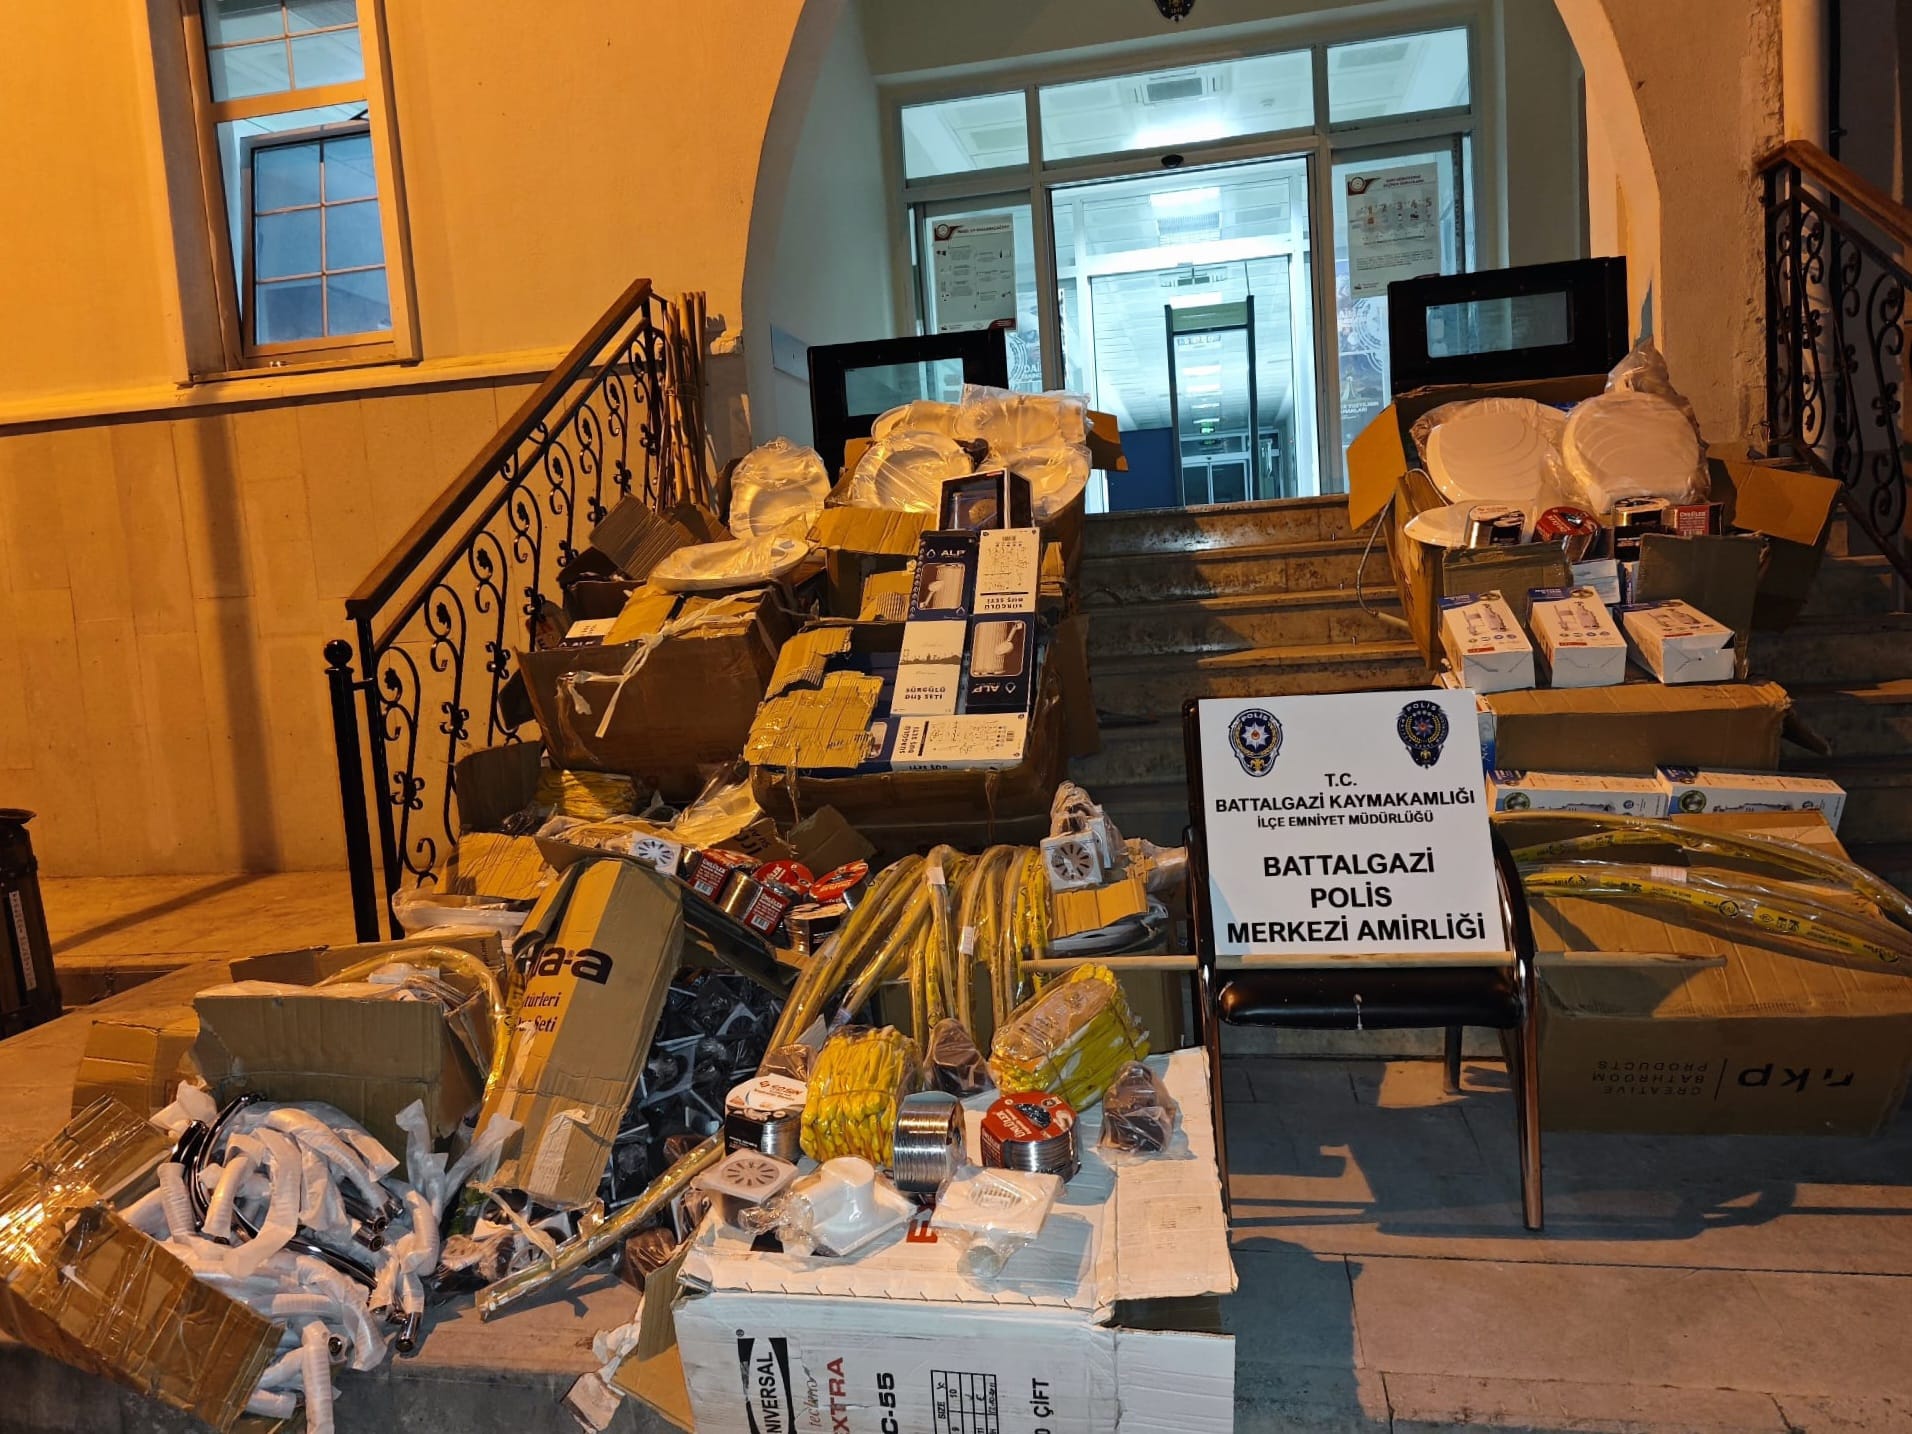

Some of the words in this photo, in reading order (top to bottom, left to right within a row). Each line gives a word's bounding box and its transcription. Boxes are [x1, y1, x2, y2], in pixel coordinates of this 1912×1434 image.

[1324, 772, 1358, 787] T.C.
[1215, 792, 1325, 813] BATTALGAZİ
[1329, 787, 1475, 809] KAYMAKAMLIĞI
[1257, 814, 1285, 829] İLÇE
[1288, 812, 1345, 828] EMNİYET
[1348, 809, 1434, 825] MÜDÜRLÜĞÜ
[1263, 847, 1435, 877] BATTALGAZİ
[1310, 881, 1393, 909] POLİS
[1227, 915, 1349, 944] MERKEZİ
[1357, 912, 1487, 942] AMİRLİĞİ
[1592, 1073, 1705, 1083] BATHROOM
[1598, 1061, 1708, 1072] PRODUCTS
[1603, 1086, 1701, 1096] CREATIVE
[827, 1356, 850, 1434] XTRA
[1029, 1377, 1054, 1418] ÇİFT
[936, 1401, 946, 1420] SIZE
